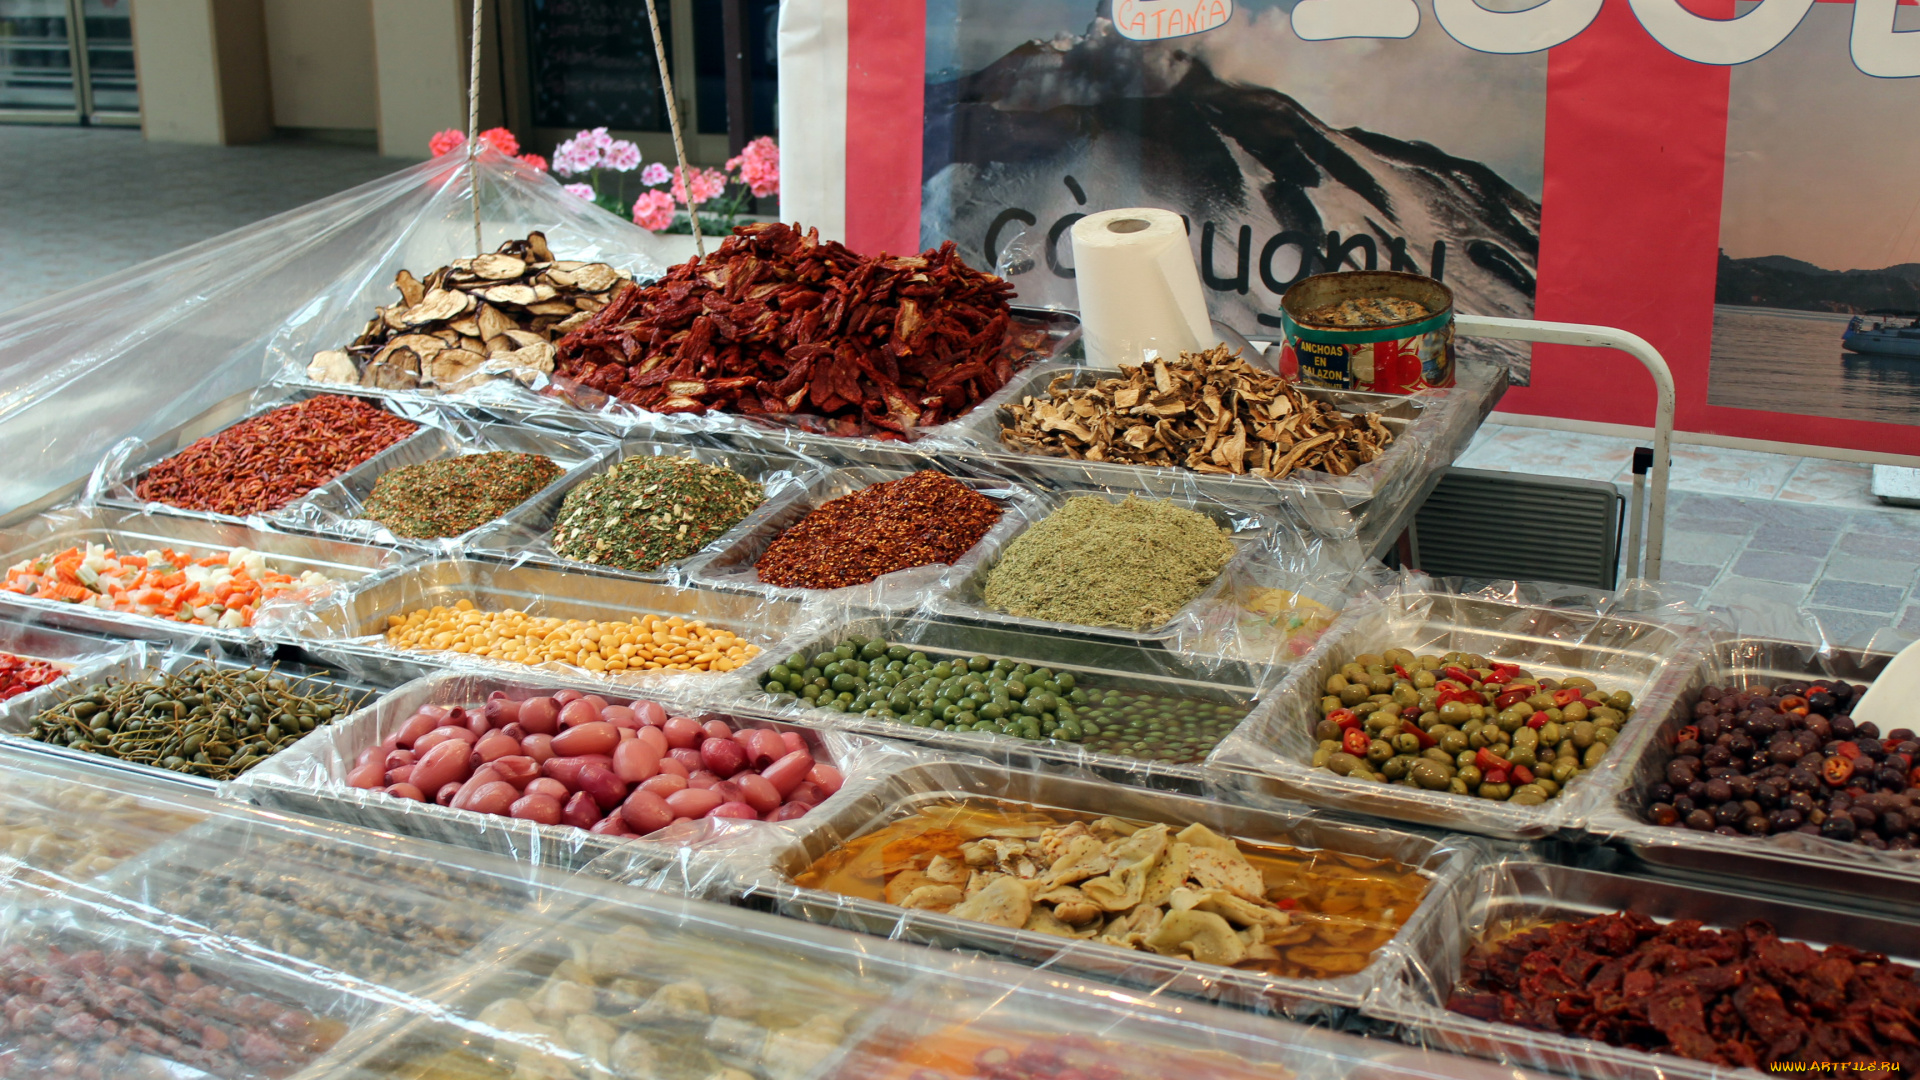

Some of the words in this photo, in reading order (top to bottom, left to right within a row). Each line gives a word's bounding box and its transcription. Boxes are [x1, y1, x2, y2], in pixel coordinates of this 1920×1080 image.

[1301, 341, 1344, 356] ANCHOAS
[1314, 356, 1327, 367] EN
[1302, 365, 1343, 380] SALAZON
